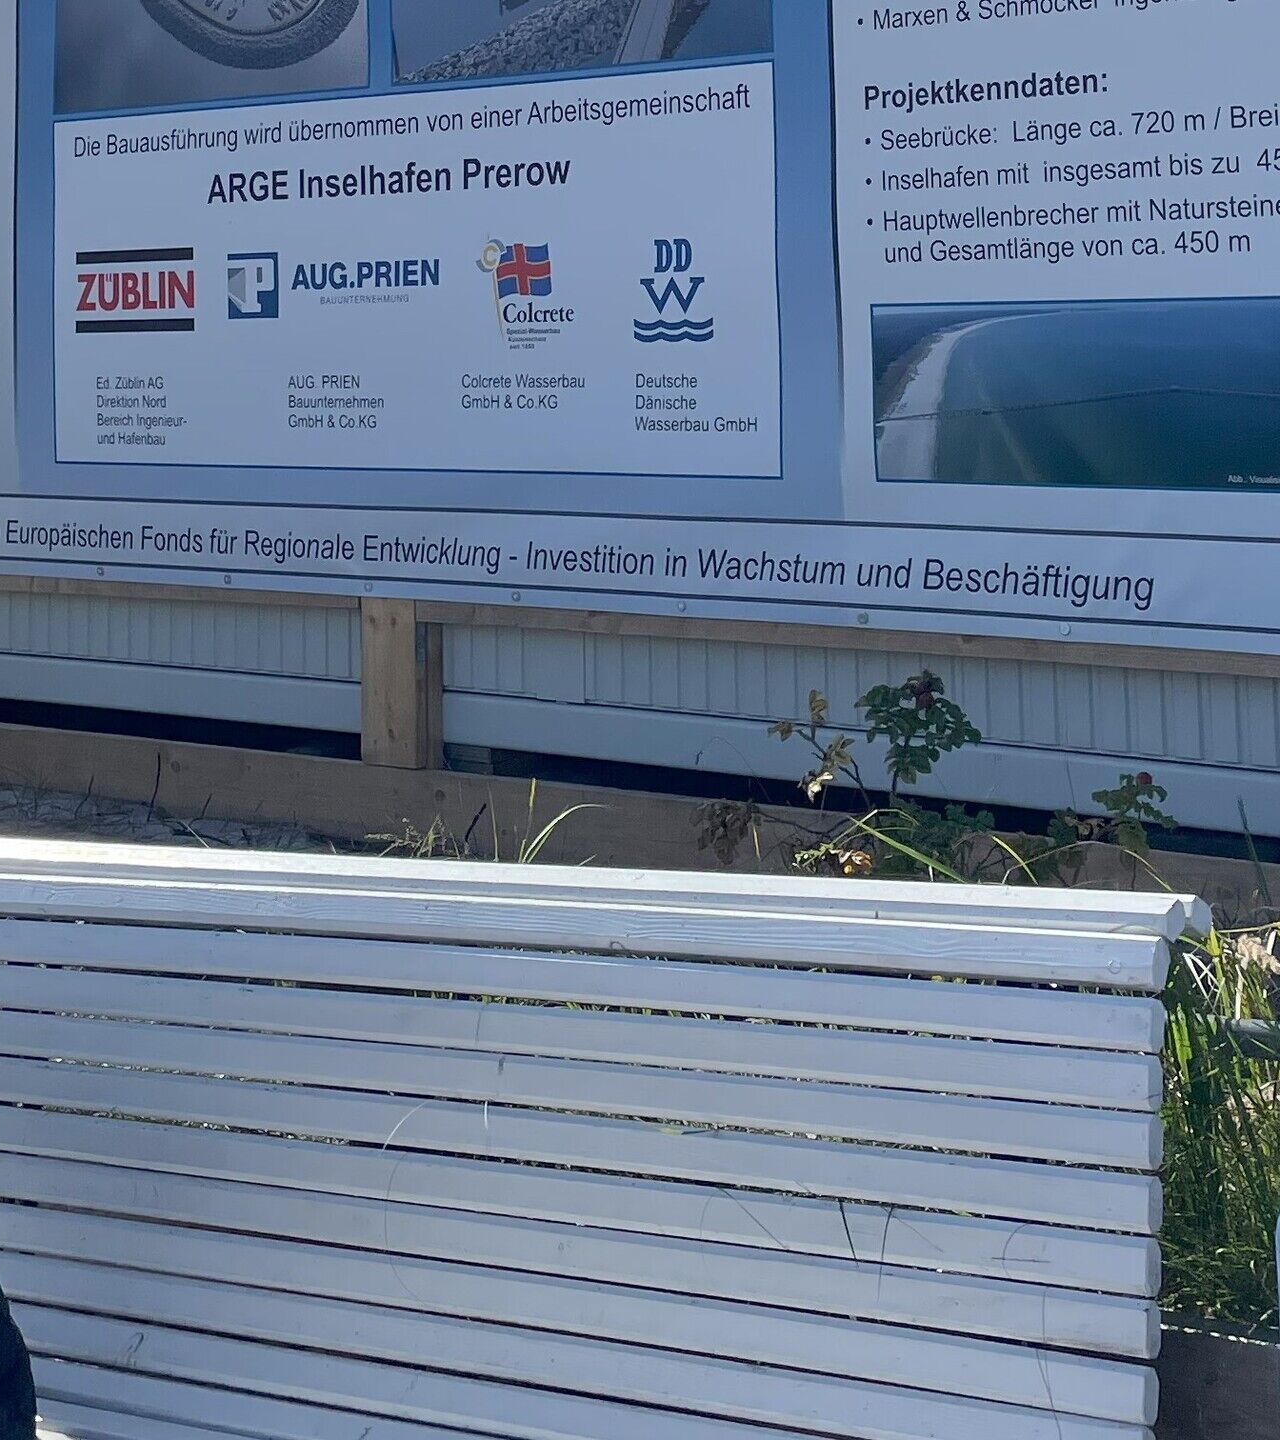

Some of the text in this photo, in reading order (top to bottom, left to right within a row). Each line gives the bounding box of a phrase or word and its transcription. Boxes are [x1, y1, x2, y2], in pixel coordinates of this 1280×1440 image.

[873, 7, 948, 31] Marxen
[864, 70, 1108, 114] Projektkenndaten:
[74, 83, 751, 158] Die Bauausführung wird übernommen von einer Arbeitsgemeinschaft
[880, 123, 998, 151] Seebrücke:
[1012, 119, 1082, 146] Länge
[1089, 119, 1123, 138] ca.
[1131, 109, 1175, 135] 720
[1184, 113, 1205, 132] m
[207, 158, 571, 205] ARGE Inselhafen Prerow
[882, 165, 989, 191] Inselhafen
[997, 162, 1030, 186] mit
[1043, 155, 1162, 187] insgesamt
[1169, 152, 1203, 177] bis
[1211, 155, 1240, 175] zu
[883, 202, 1100, 236] Hauptwellenbrecher
[1106, 199, 1142, 223] mit
[653, 238, 693, 273] DD
[884, 229, 1251, 264] und Gesamtlänge von ca. 450 m
[290, 258, 440, 291] AUG.PRIEN
[75, 269, 195, 312] ZÜBLIN
[502, 301, 575, 324] Colcrete
[114, 375, 146, 390] Züblin
[147, 375, 165, 390] AG
[287, 374, 360, 390] AUG. PRIEN
[461, 373, 586, 389] Colcrete Wasserbau
[635, 373, 698, 389] Deutsche
[96, 394, 167, 409] Direktion Nord
[287, 394, 385, 410] Bauunternehmen
[461, 393, 558, 410] GmbH Co.KG
[635, 394, 697, 411] Dänische
[96, 412, 188, 431] Bereich Ingenieur-
[287, 413, 377, 429] GmbH Co.KG
[634, 415, 758, 433] Wasserbau GmbH
[96, 431, 167, 446] und Hafenbau
[5, 519, 134, 552] Europäischen
[141, 525, 203, 554] Fonds
[209, 527, 238, 555] für
[244, 529, 355, 565] Regionale
[363, 534, 501, 575] Entwicklung
[526, 540, 655, 576] Investition
[665, 554, 687, 578] in
[698, 548, 845, 586] Wachstum
[856, 557, 913, 589] und
[923, 559, 1155, 611] Beschäftigung
